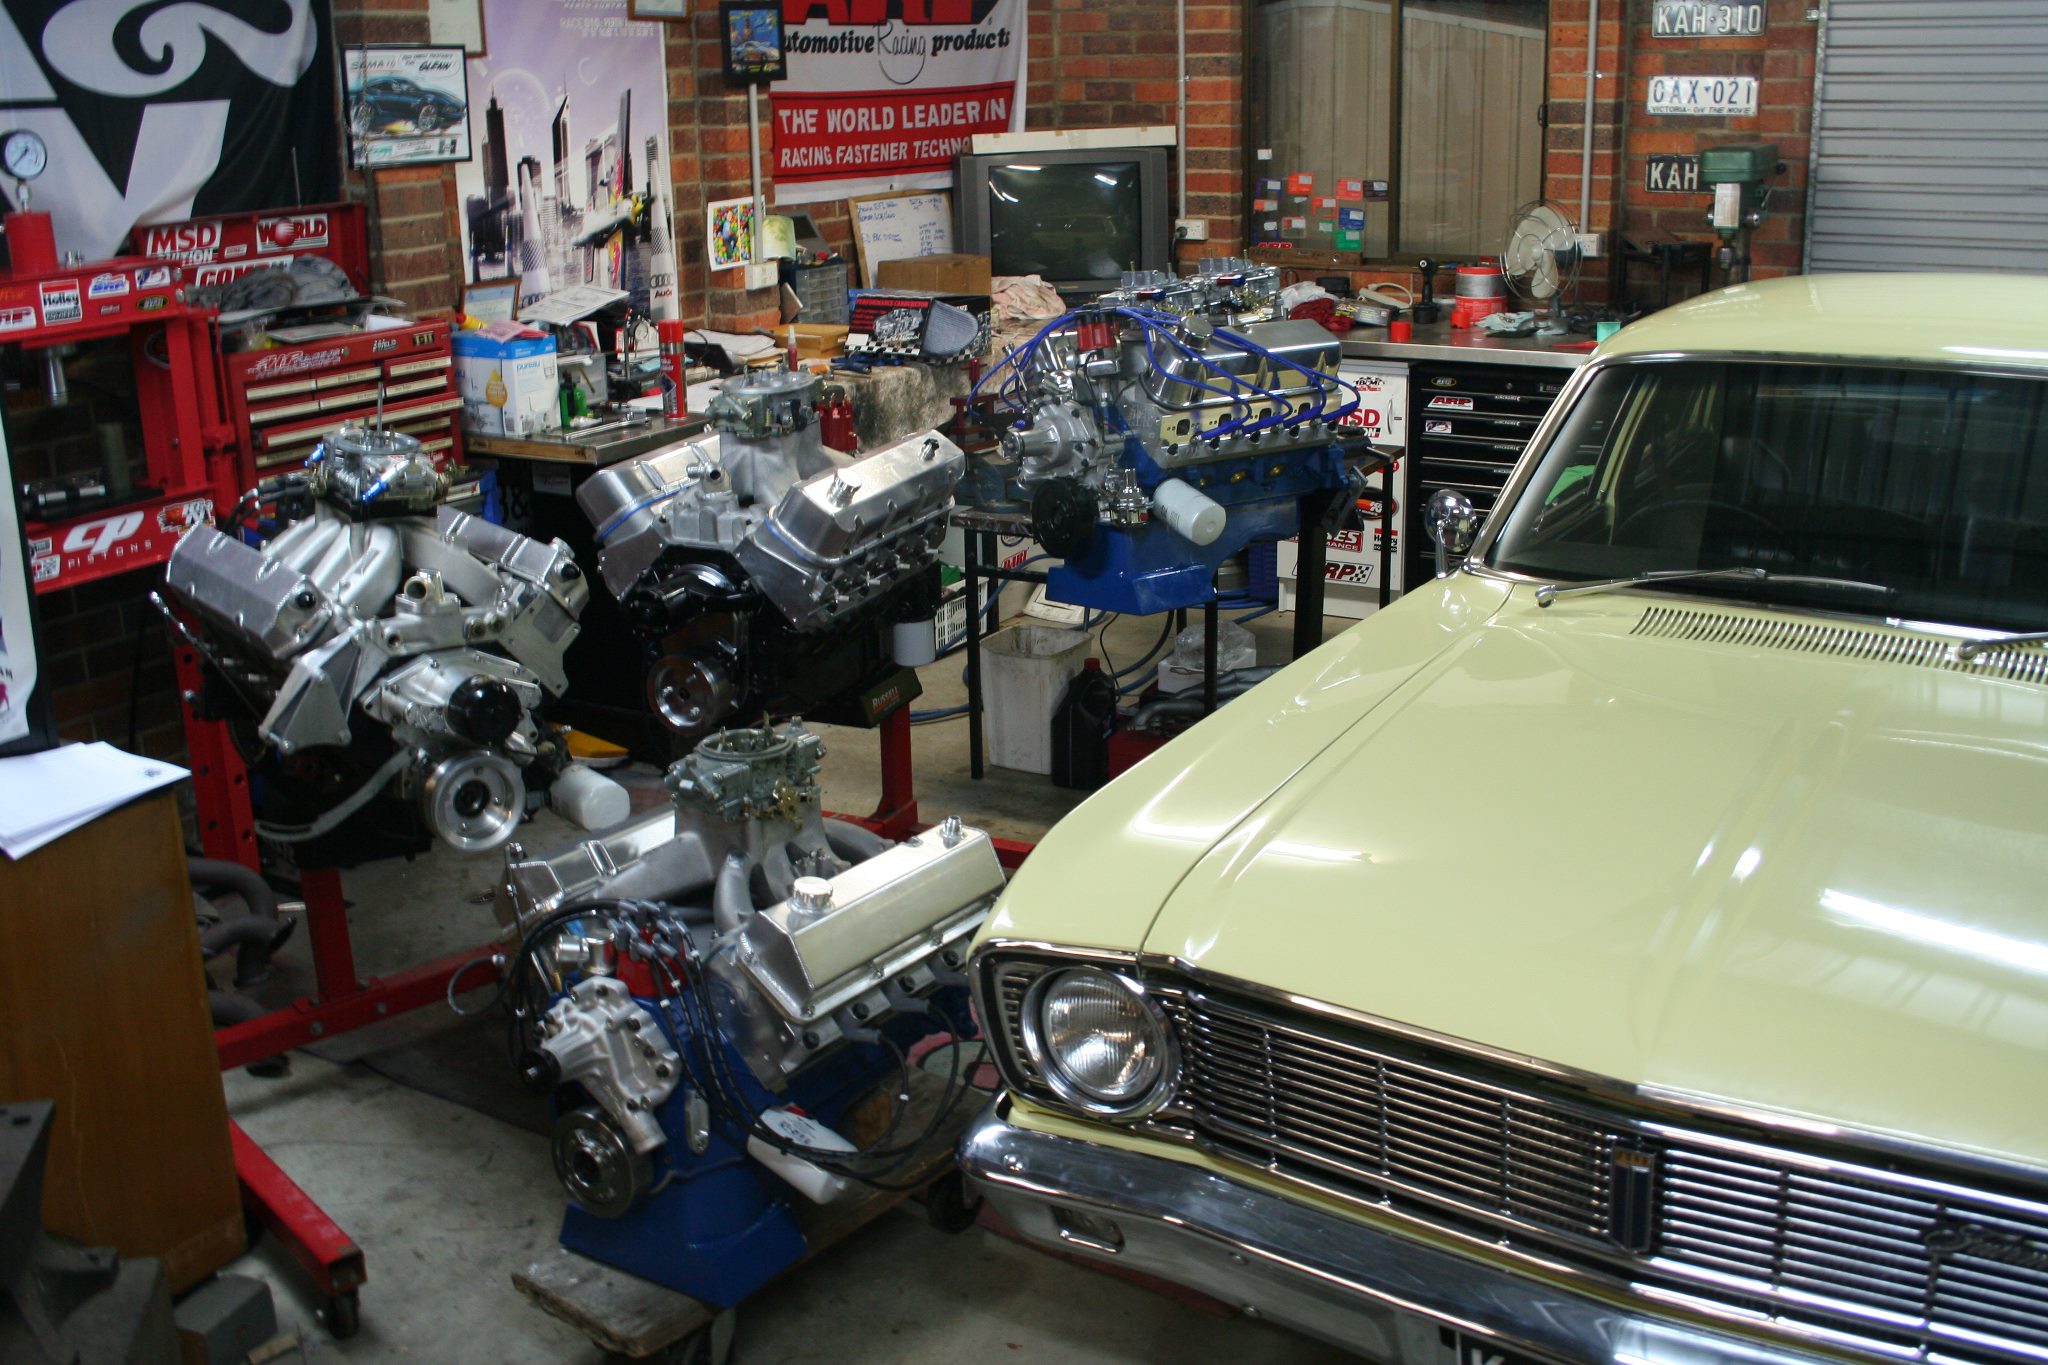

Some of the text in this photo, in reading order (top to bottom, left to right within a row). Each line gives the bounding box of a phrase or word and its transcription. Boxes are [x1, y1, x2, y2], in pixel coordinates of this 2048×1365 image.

[784, 19, 1010, 85] utomotive Racing products
[778, 97, 1007, 135] THE WORLD LEADER IN
[780, 146, 833, 169] RACING
[836, 141, 907, 165] FASTENER
[1651, 162, 1699, 190] KAH
[152, 223, 217, 254] MSD
[43, 291, 80, 308] Holley
[654, 289, 673, 298] Audi
[1433, 396, 1472, 406] ARP
[62, 510, 145, 556] CP
[67, 541, 152, 570] PISTONS
[1324, 562, 1358, 580] RP
